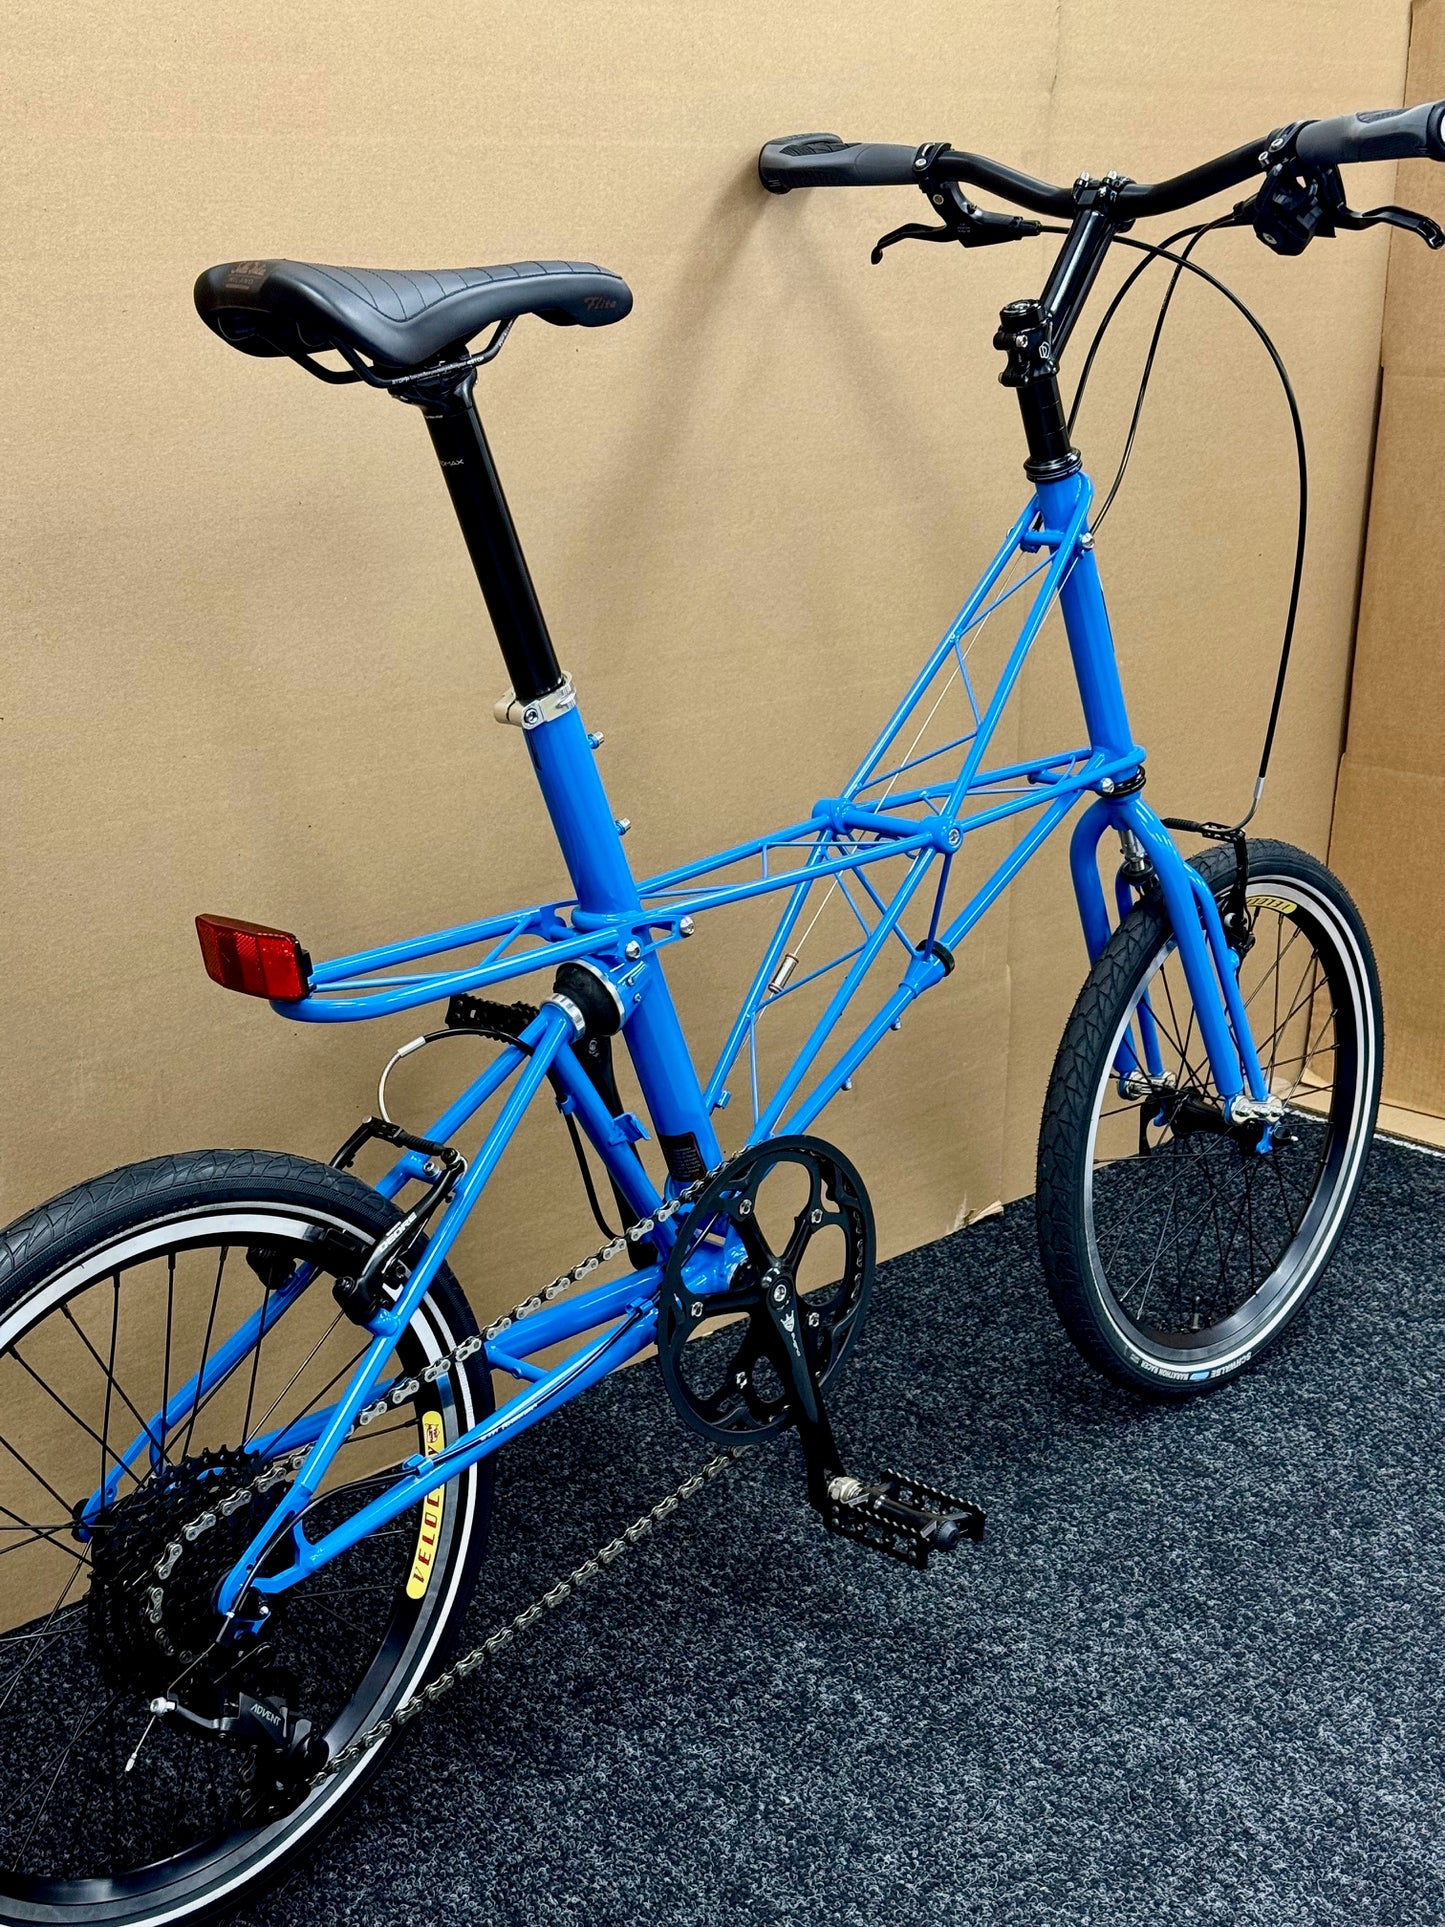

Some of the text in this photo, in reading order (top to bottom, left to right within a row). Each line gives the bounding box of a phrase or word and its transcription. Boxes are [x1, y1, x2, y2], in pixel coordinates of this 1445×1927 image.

[376, 1211, 417, 1253] DEORE
[1211, 1351, 1252, 1378] SCHWALBE
[250, 1703, 282, 1727] ADVENT
